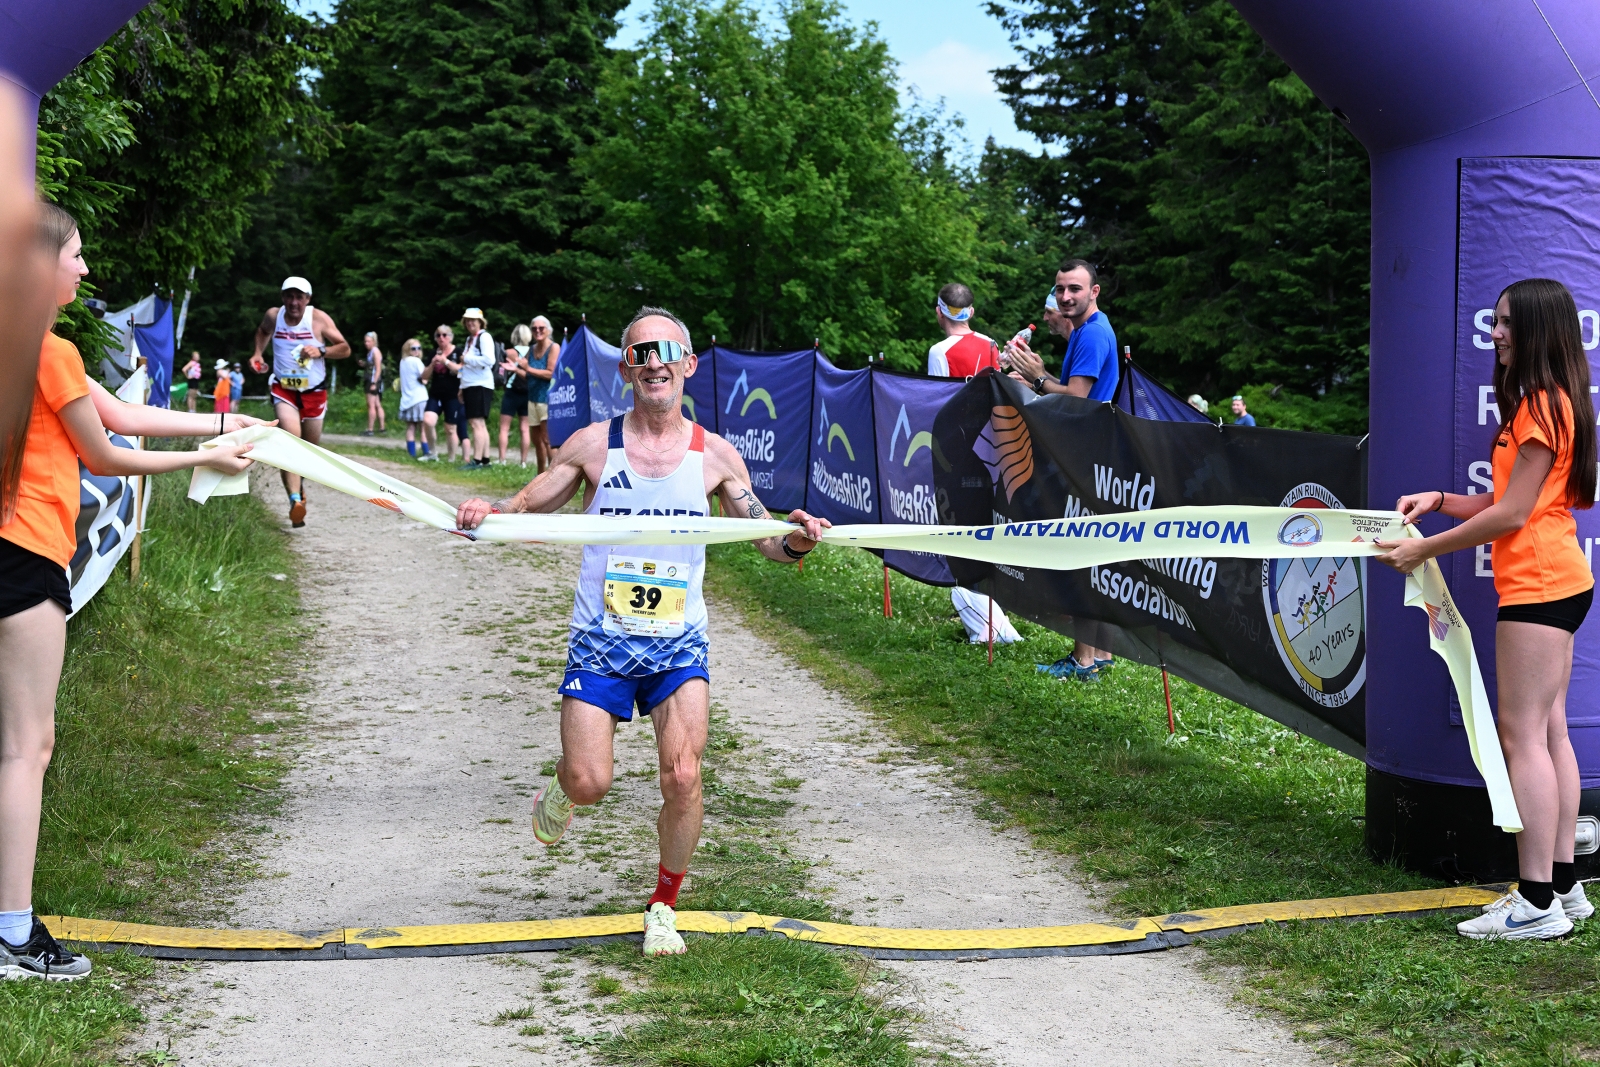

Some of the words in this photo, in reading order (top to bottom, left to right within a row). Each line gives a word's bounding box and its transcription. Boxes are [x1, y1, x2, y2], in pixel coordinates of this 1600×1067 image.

[1094, 464, 1156, 511] World
[1304, 485, 1341, 509] RUNNING
[1003, 521, 1146, 543] MOUNTAIN
[1153, 520, 1251, 544] WORLD
[629, 585, 662, 610] 39
[1091, 566, 1197, 632] Association
[1308, 645, 1322, 666] 40
[1322, 623, 1355, 660] Years
[1299, 678, 1327, 706] SINCE
[1328, 689, 1349, 707] 1984
